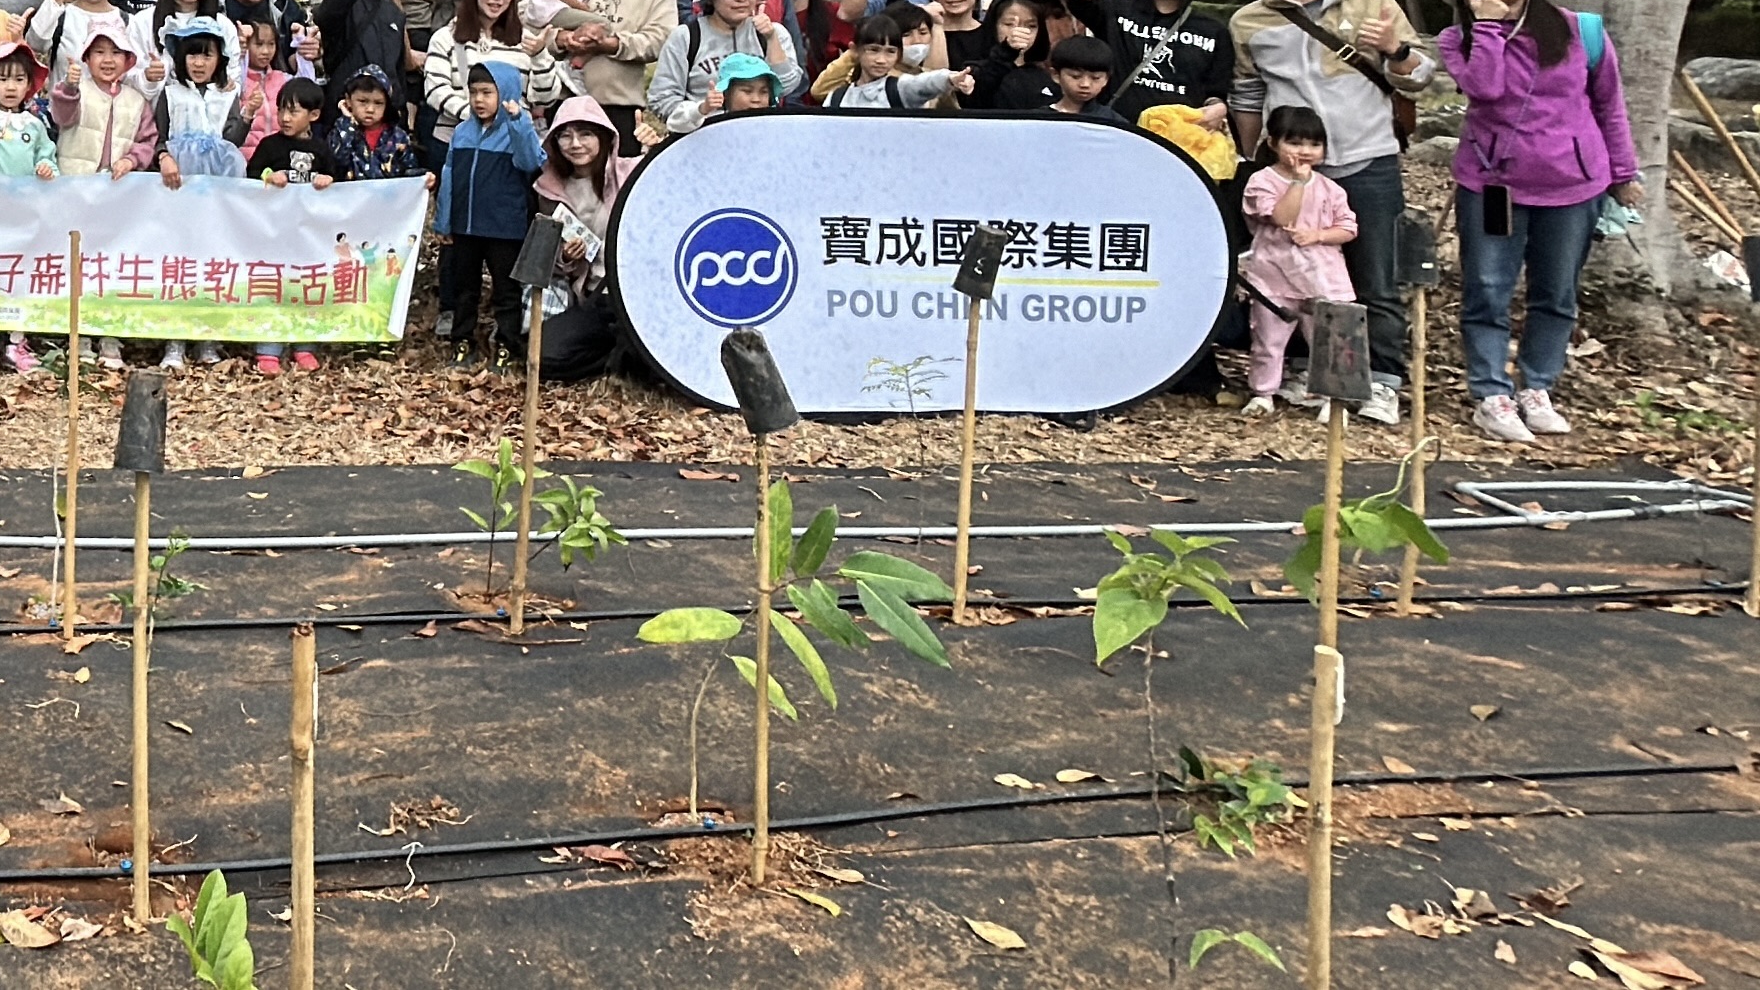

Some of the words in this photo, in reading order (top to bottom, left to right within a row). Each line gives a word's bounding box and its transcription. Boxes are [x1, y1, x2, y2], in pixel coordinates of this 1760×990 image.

[820, 216, 1150, 272] 寶成國際集團
[826, 289, 898, 318] POU
[911, 291, 1009, 321] CHN
[1021, 293, 1147, 323] GROUP
